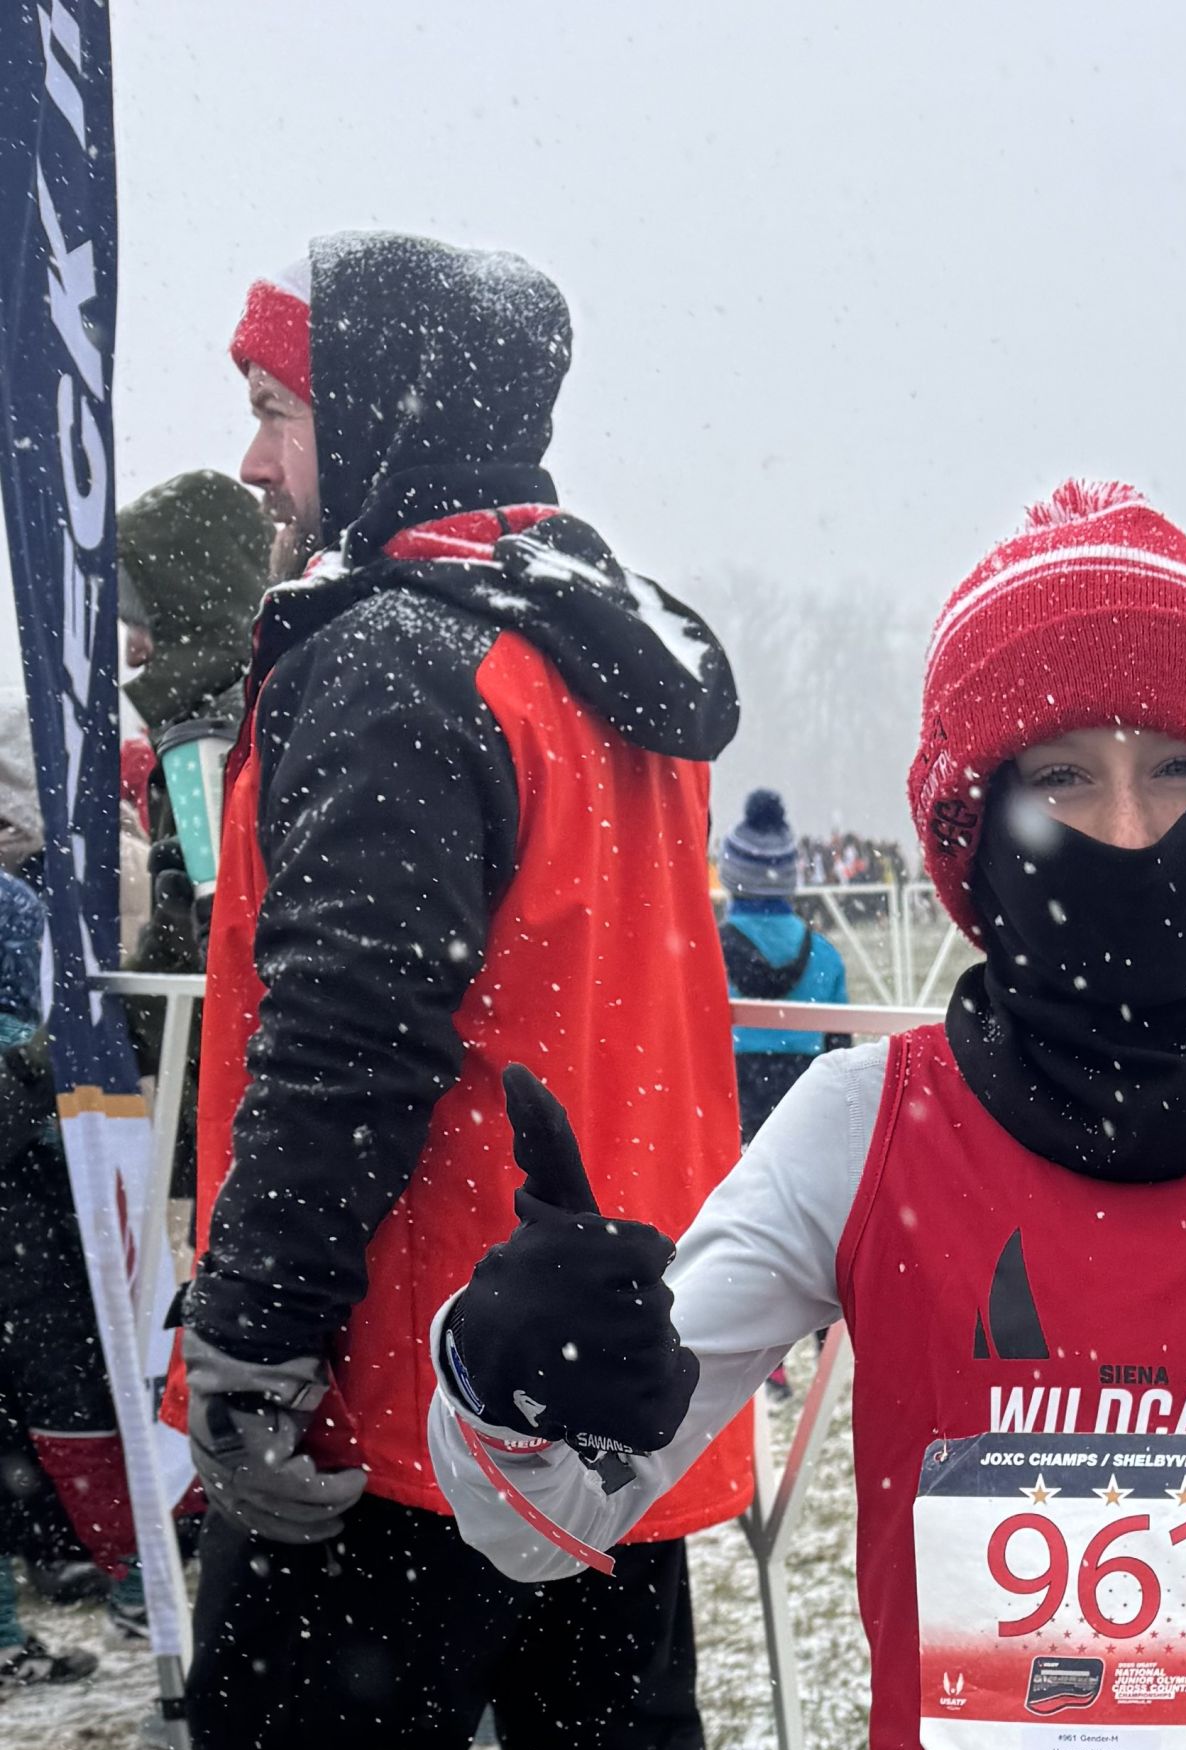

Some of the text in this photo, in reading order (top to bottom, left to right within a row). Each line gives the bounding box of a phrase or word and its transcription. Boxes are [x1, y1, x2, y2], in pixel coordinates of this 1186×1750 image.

[1100, 1365, 1169, 1384] SIENA
[980, 1453, 1025, 1466] JOXC
[1028, 1453, 1097, 1467] CHAMPS
[1100, 1453, 1109, 1467] /
[1115, 1668, 1166, 1677] NATIONAL
[1115, 1676, 1154, 1685] JUNIOR
[1112, 1684, 1147, 1693] CROSS
